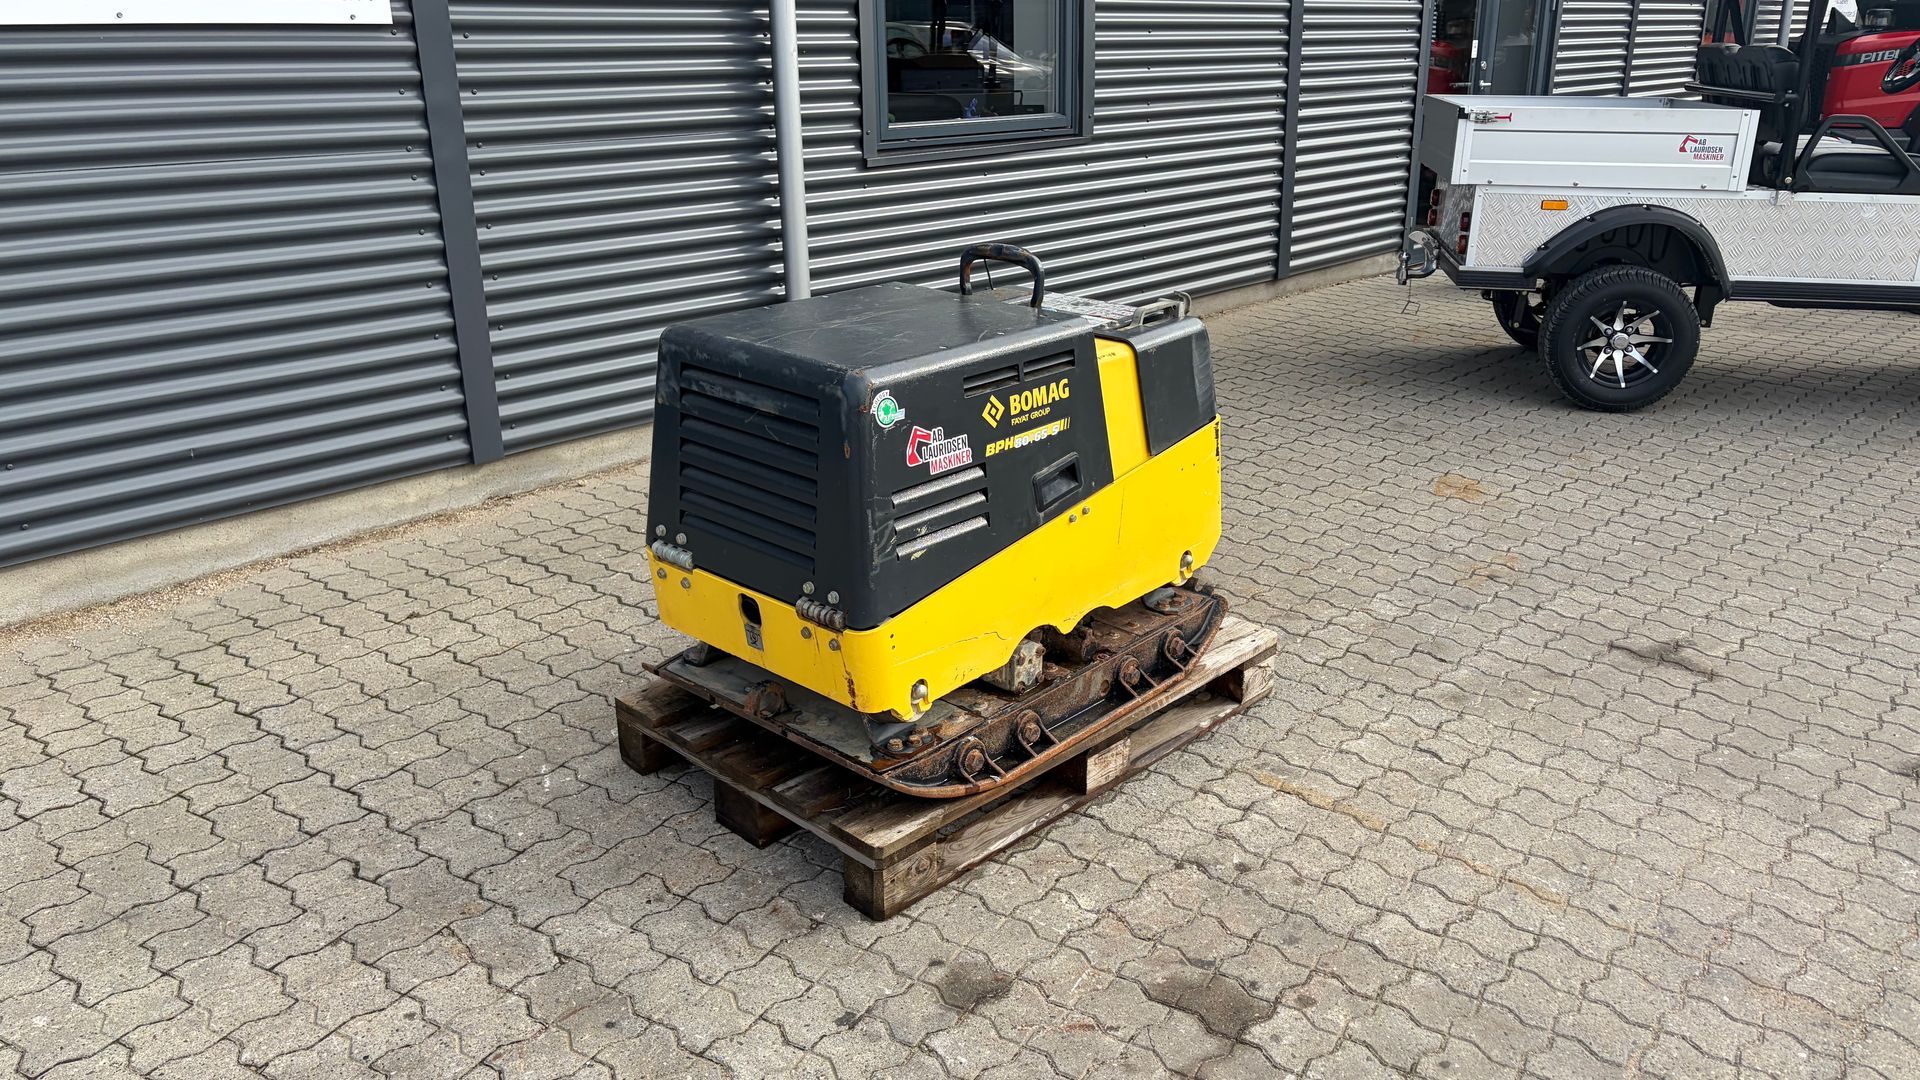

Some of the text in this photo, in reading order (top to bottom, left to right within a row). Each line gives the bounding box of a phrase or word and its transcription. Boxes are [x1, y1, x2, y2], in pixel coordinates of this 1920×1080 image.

[1693, 153, 1724, 161] MASKINER
[1009, 378, 1070, 416] BOMAG
[1011, 407, 1051, 426] FAYAT GROUP
[932, 428, 943, 443] AB
[922, 435, 968, 461] LAURIDSEN
[930, 449, 972, 474] MASKINER
